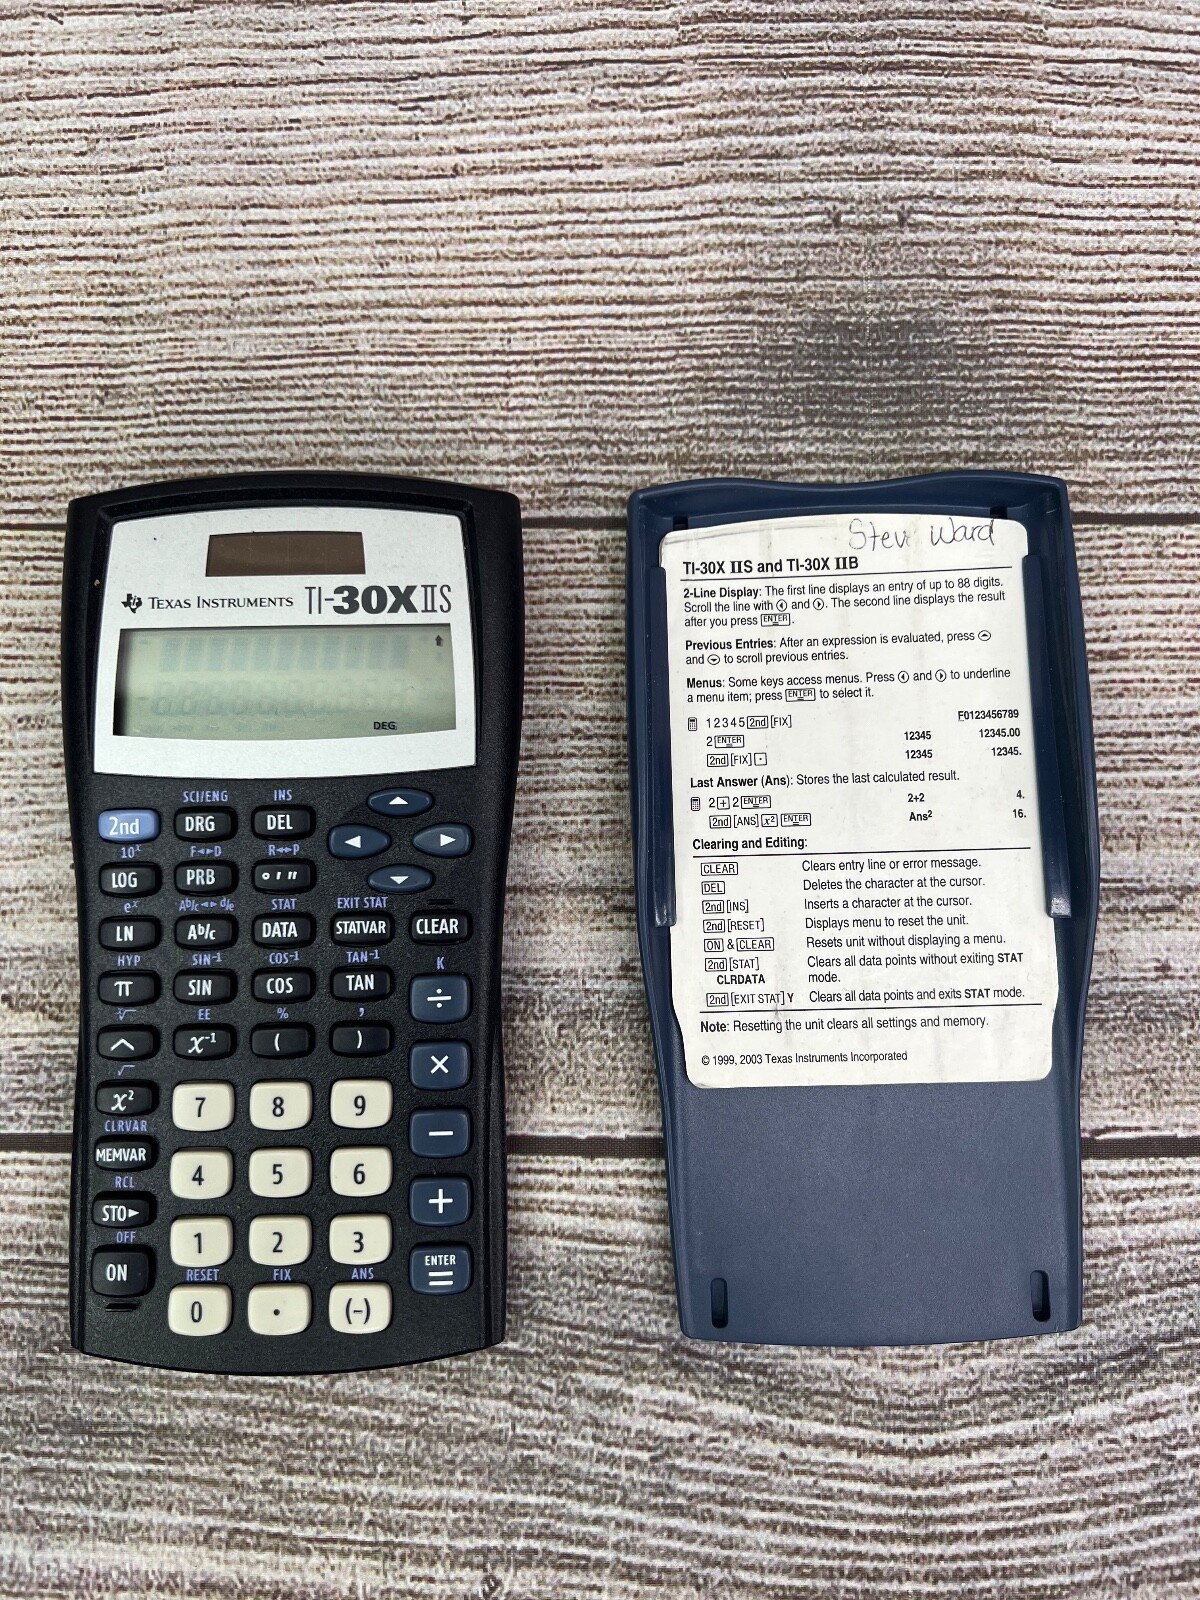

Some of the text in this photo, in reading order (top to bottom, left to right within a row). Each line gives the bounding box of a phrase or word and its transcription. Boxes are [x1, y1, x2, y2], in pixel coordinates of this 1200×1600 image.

[931, 517, 994, 546] Ward
[683, 556, 858, 575] TI-30X IIS TI-30X IIB
[683, 576, 1004, 600] 2-Line Display: The first line displays entry 88 digits.
[684, 591, 1006, 612] Scroll line with The second line displays result
[684, 615, 758, 629] after you press
[685, 631, 975, 651] Previous Entries: After expression evaluated, press
[736, 649, 849, 663] scroll previous entries.
[687, 667, 1011, 688] Menus: Some keys access menus. Press underline
[696, 687, 860, 703] menu item; press select
[958, 709, 1019, 722] F0123456789
[373, 722, 397, 730] DEG
[979, 727, 1021, 738] 12345.00
[904, 730, 932, 741] 12345
[905, 749, 932, 760] 12345
[991, 746, 1022, 757] 12345.
[690, 769, 959, 788] Last Answer (Ans): Stores last calculated result.
[183, 790, 228, 803] SCI/ENG
[274, 790, 292, 801] INS
[1012, 809, 1026, 819] 16.
[109, 817, 140, 835] 2nd
[185, 817, 215, 832] DRG
[266, 815, 293, 830] DEL
[692, 836, 808, 851] Clearing Editing:
[703, 864, 736, 874] CLEAR
[802, 857, 982, 873] Clears entry line error message.
[112, 872, 137, 888] LOG
[186, 869, 215, 885] PRB
[803, 876, 985, 891] Deletes character cursor.
[704, 882, 723, 894] DEL
[272, 899, 296, 910] STAT
[337, 897, 387, 909] EXIT STAT
[804, 896, 972, 909] Inserts character cursor.
[336, 920, 386, 935] STATVAR
[416, 919, 459, 934] CLEAR
[805, 914, 969, 930] Displays menu reset unit.
[115, 926, 133, 941] LN
[262, 922, 298, 938] DATA
[707, 939, 772, 951] ON CLEAR
[806, 934, 1006, 948] Resets unit without displaying menu.
[117, 955, 140, 966] HYP
[807, 952, 1023, 968] Clears all data points without exiting STAT
[346, 974, 375, 991] TAN
[717, 974, 765, 985] CLRDATA
[808, 972, 841, 983] mode.
[188, 980, 212, 995] SIN
[266, 978, 293, 993] COS
[809, 987, 1024, 1003] Clears all data points exits STAT mode.
[198, 1008, 211, 1021] EE
[700, 1016, 989, 1034] Note: Resetting unit clears all settings memory.
[712, 1050, 907, 1066] 1999, 2003 Texas Instruments Incorporated
[195, 1097, 206, 1118] 7
[272, 1097, 285, 1117] 8
[354, 1095, 366, 1116] 9
[105, 1120, 148, 1132] CLRVAR
[96, 1148, 146, 1162] MEMVAR
[192, 1165, 204, 1186] 4
[272, 1164, 283, 1185] 5
[353, 1163, 366, 1185] 6
[115, 1177, 134, 1188] RCL
[116, 1231, 136, 1243] OFF
[194, 1233, 203, 1254] 1
[272, 1232, 283, 1253] 2
[353, 1231, 364, 1253] 3
[424, 1254, 456, 1266] ENTER
[106, 1263, 128, 1281] ON
[186, 1269, 219, 1281] RESET
[273, 1269, 291, 1280] FIX
[352, 1268, 374, 1279] ANS
[191, 1301, 203, 1322] 0
